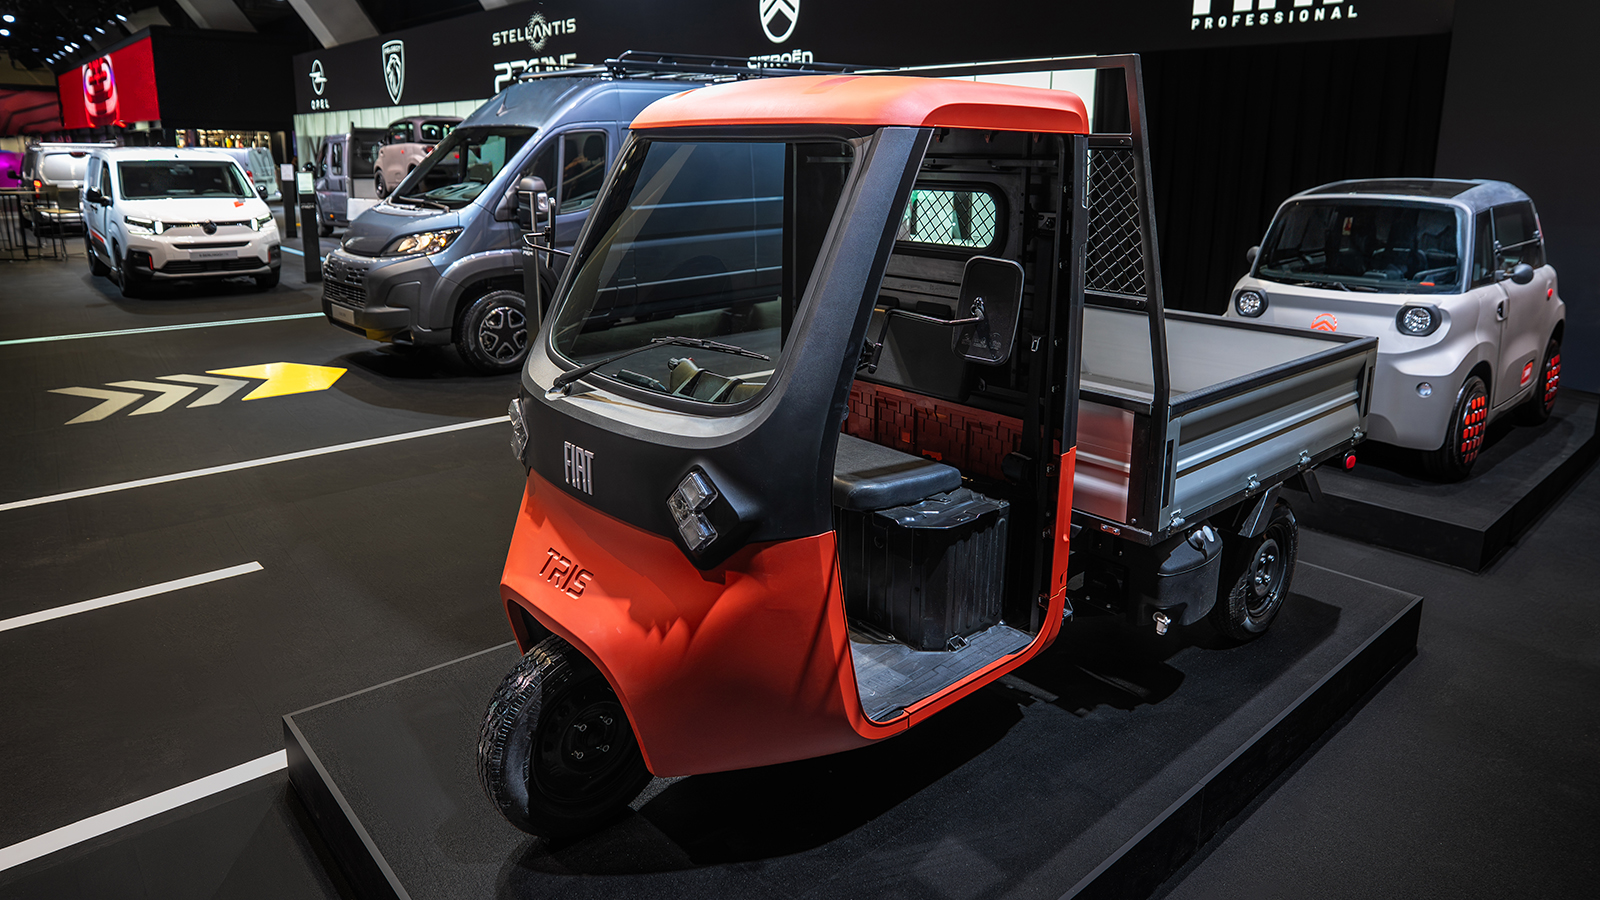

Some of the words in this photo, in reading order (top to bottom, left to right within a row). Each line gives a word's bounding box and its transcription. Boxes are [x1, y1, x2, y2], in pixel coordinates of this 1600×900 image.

[1191, 5, 1358, 30] PROFESSIONAL
[492, 18, 576, 46] STELLANTIS
[311, 98, 330, 110] OPEL
[564, 440, 594, 496] FIAT
[539, 547, 594, 600] TRIS
